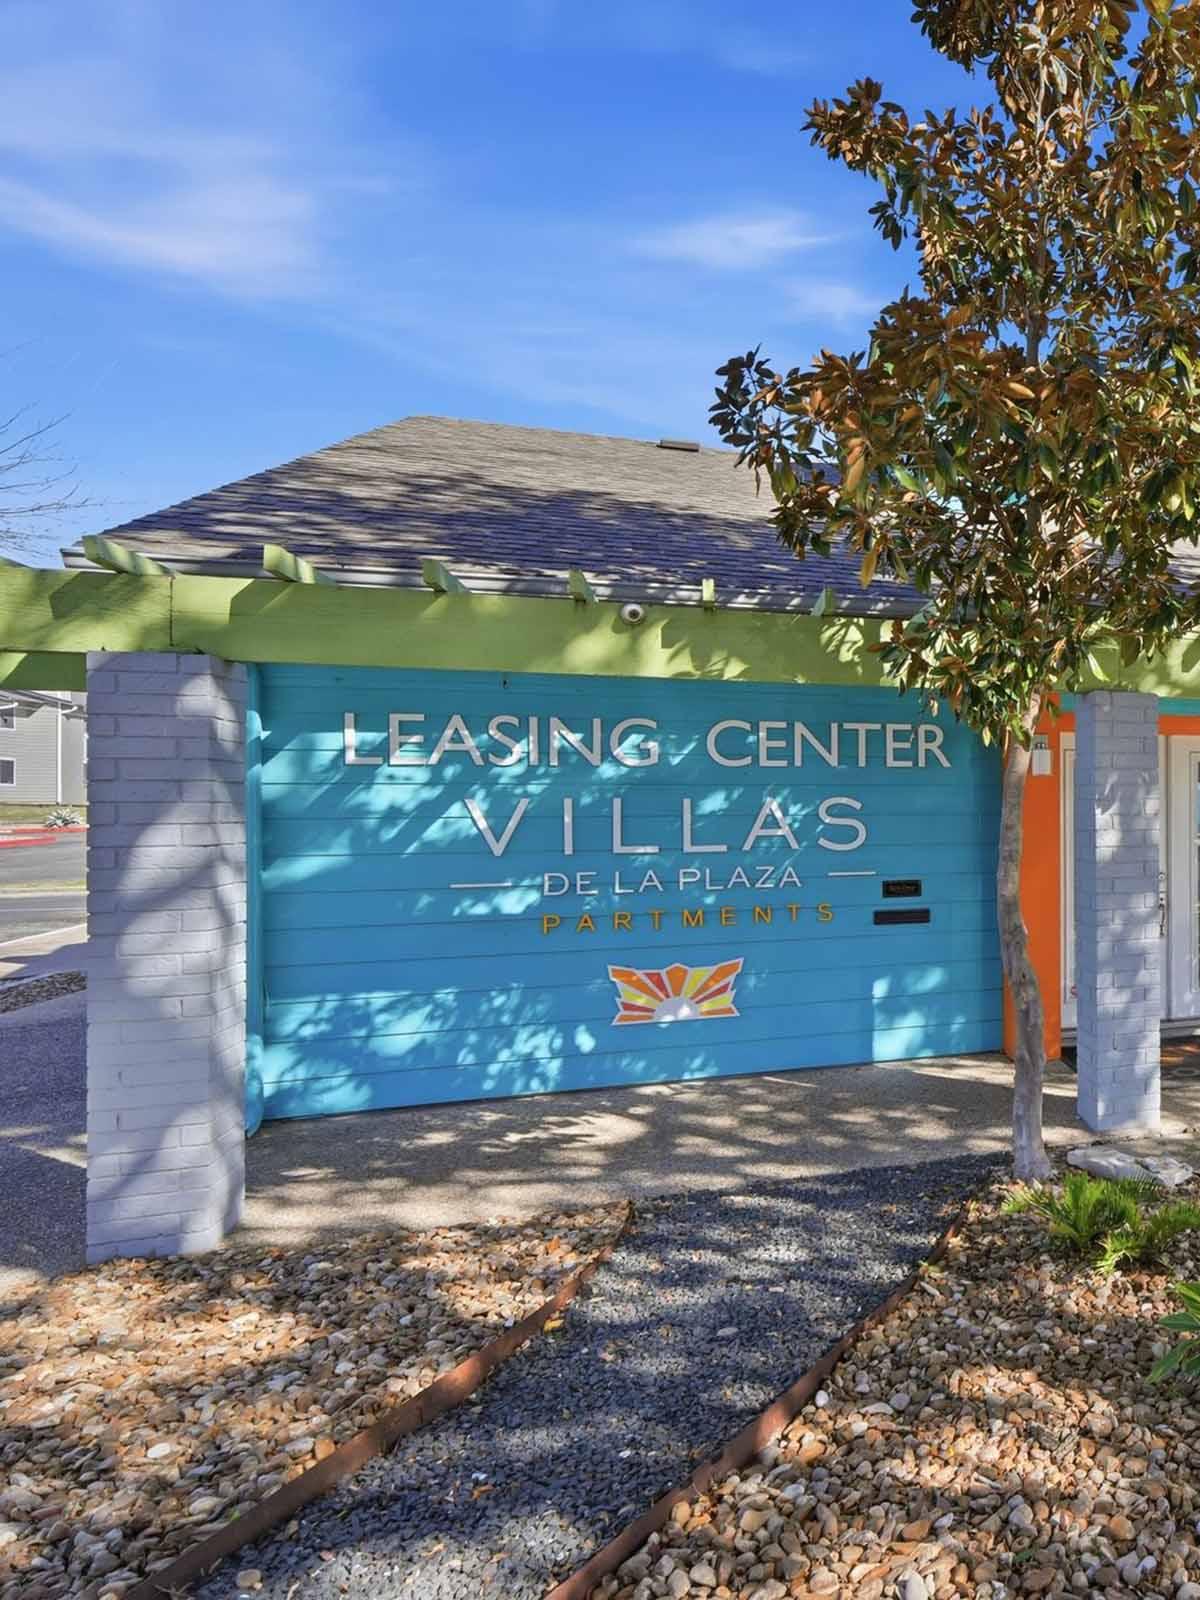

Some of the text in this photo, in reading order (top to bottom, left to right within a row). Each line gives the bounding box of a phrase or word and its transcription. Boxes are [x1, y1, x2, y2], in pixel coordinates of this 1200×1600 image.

[343, 712, 952, 767] LEASING CENTER
[463, 796, 868, 857] VILLAS
[543, 865, 803, 896] DE LA PLAZA
[543, 903, 834, 935] PARTMENTS
